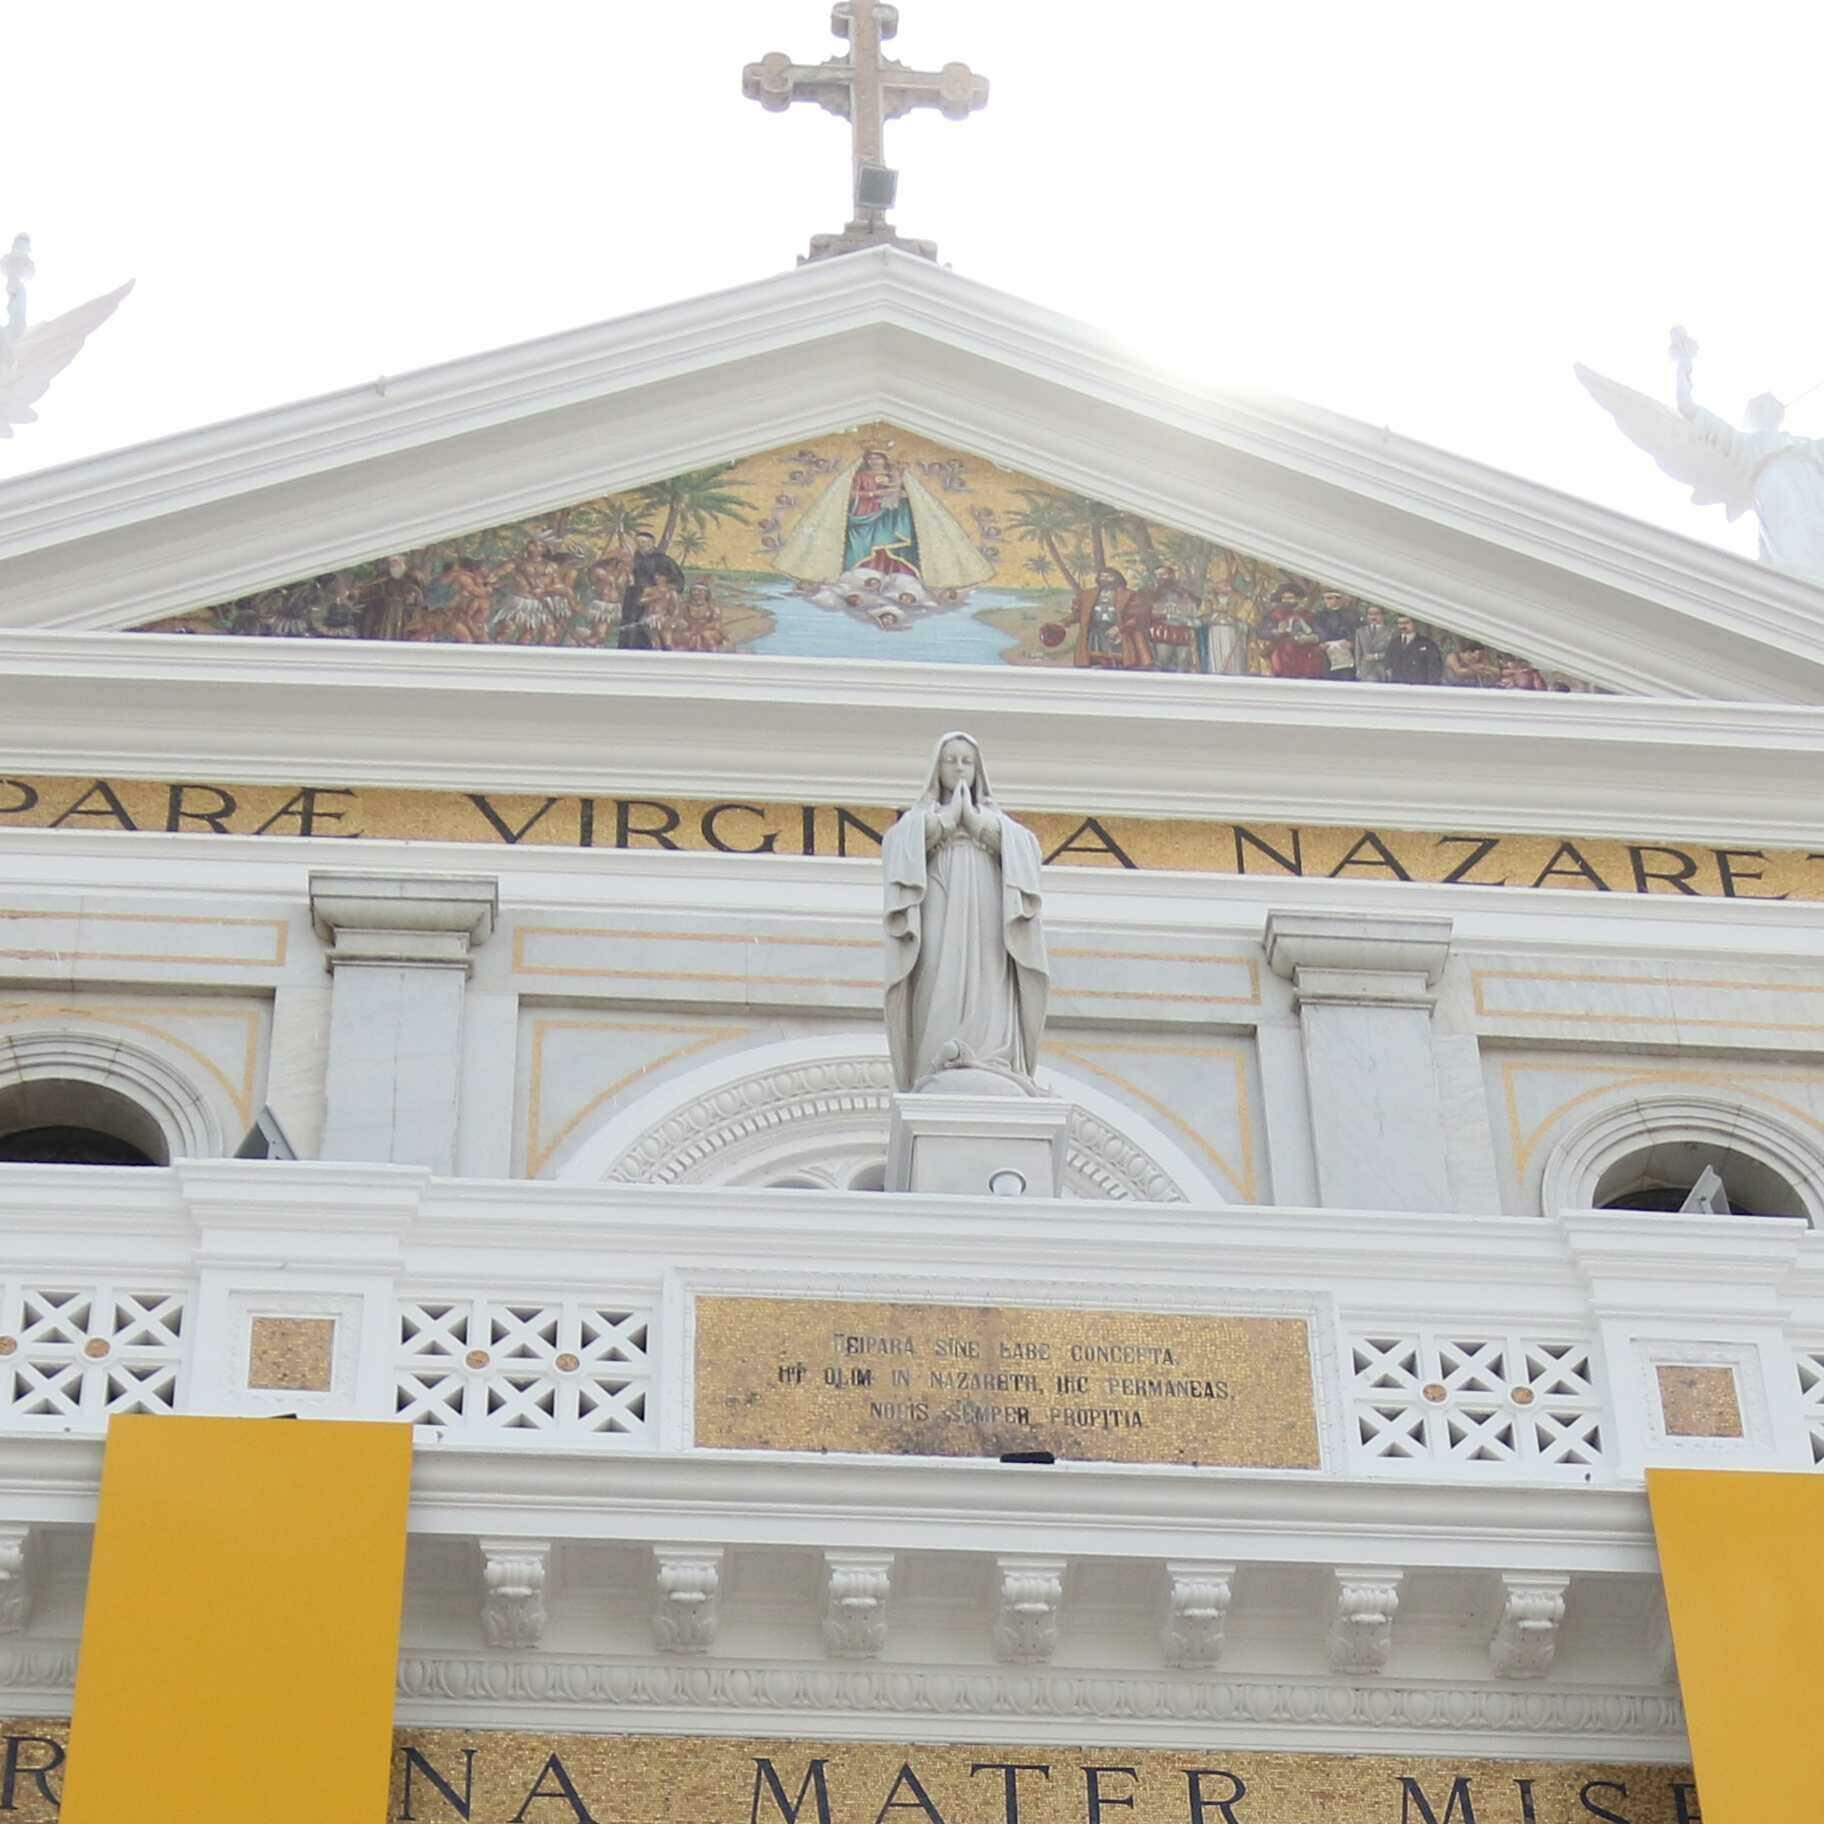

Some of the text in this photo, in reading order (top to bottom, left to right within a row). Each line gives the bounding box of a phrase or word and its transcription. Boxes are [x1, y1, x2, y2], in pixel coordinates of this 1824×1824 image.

[463, 793, 904, 858] VIRGIN
[935, 1338, 980, 1360] SINE
[892, 1370, 911, 1388] IN
